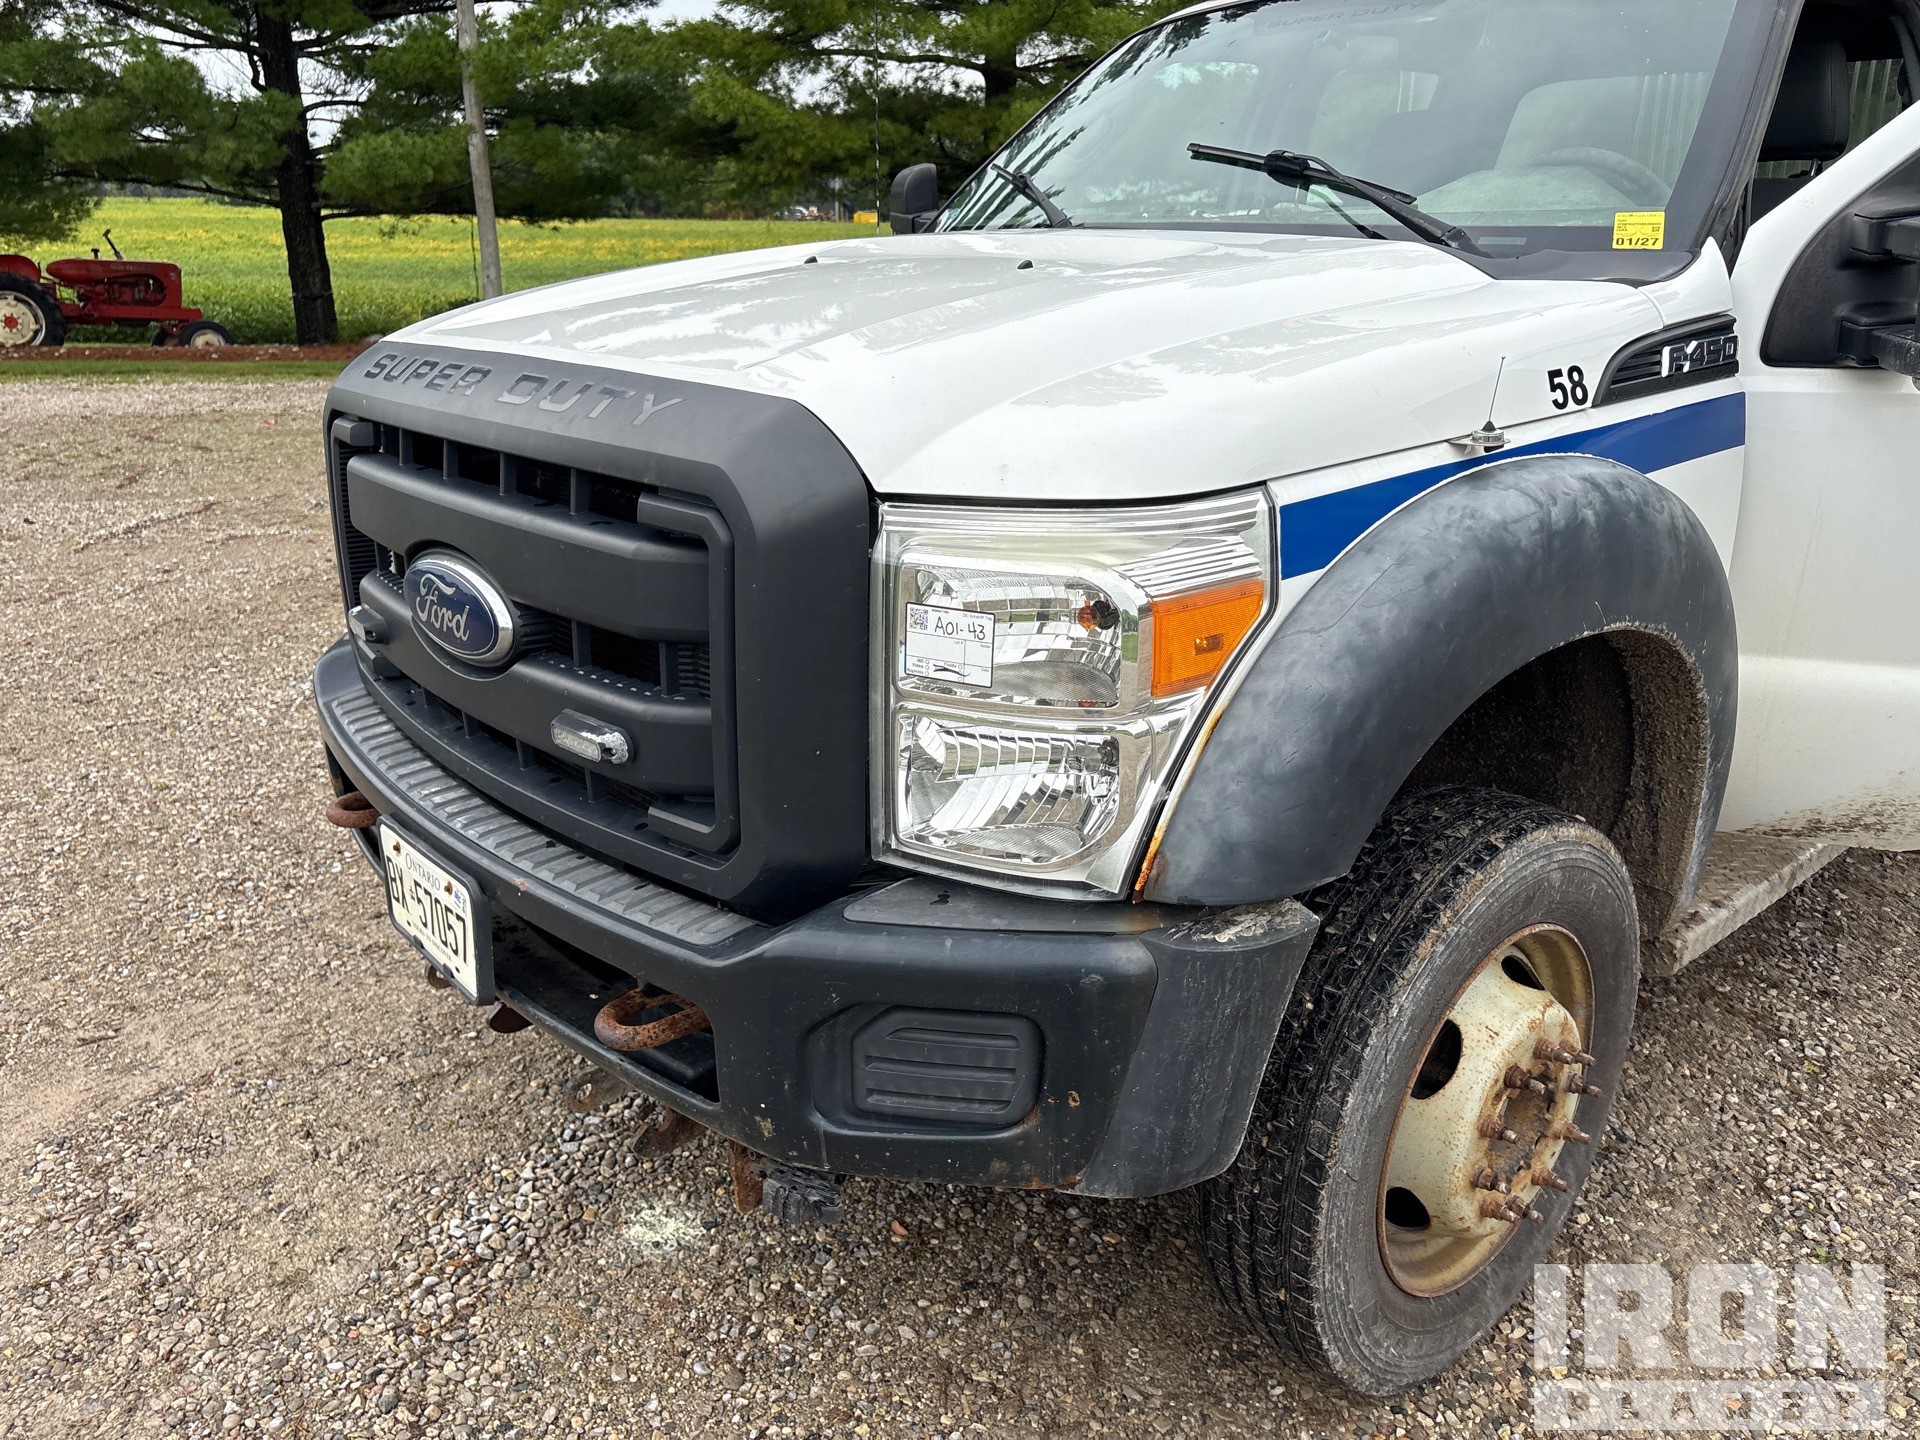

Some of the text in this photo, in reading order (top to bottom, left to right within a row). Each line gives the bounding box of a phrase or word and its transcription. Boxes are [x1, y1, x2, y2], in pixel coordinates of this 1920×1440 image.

[1616, 237, 1659, 246] 01/27
[363, 353, 684, 426] SUPER DUTY
[1547, 365, 1588, 410] 58
[415, 573, 470, 642] Ford
[405, 852, 441, 891] ONTARIO
[386, 855, 410, 914] BX
[413, 878, 468, 964] 57057
